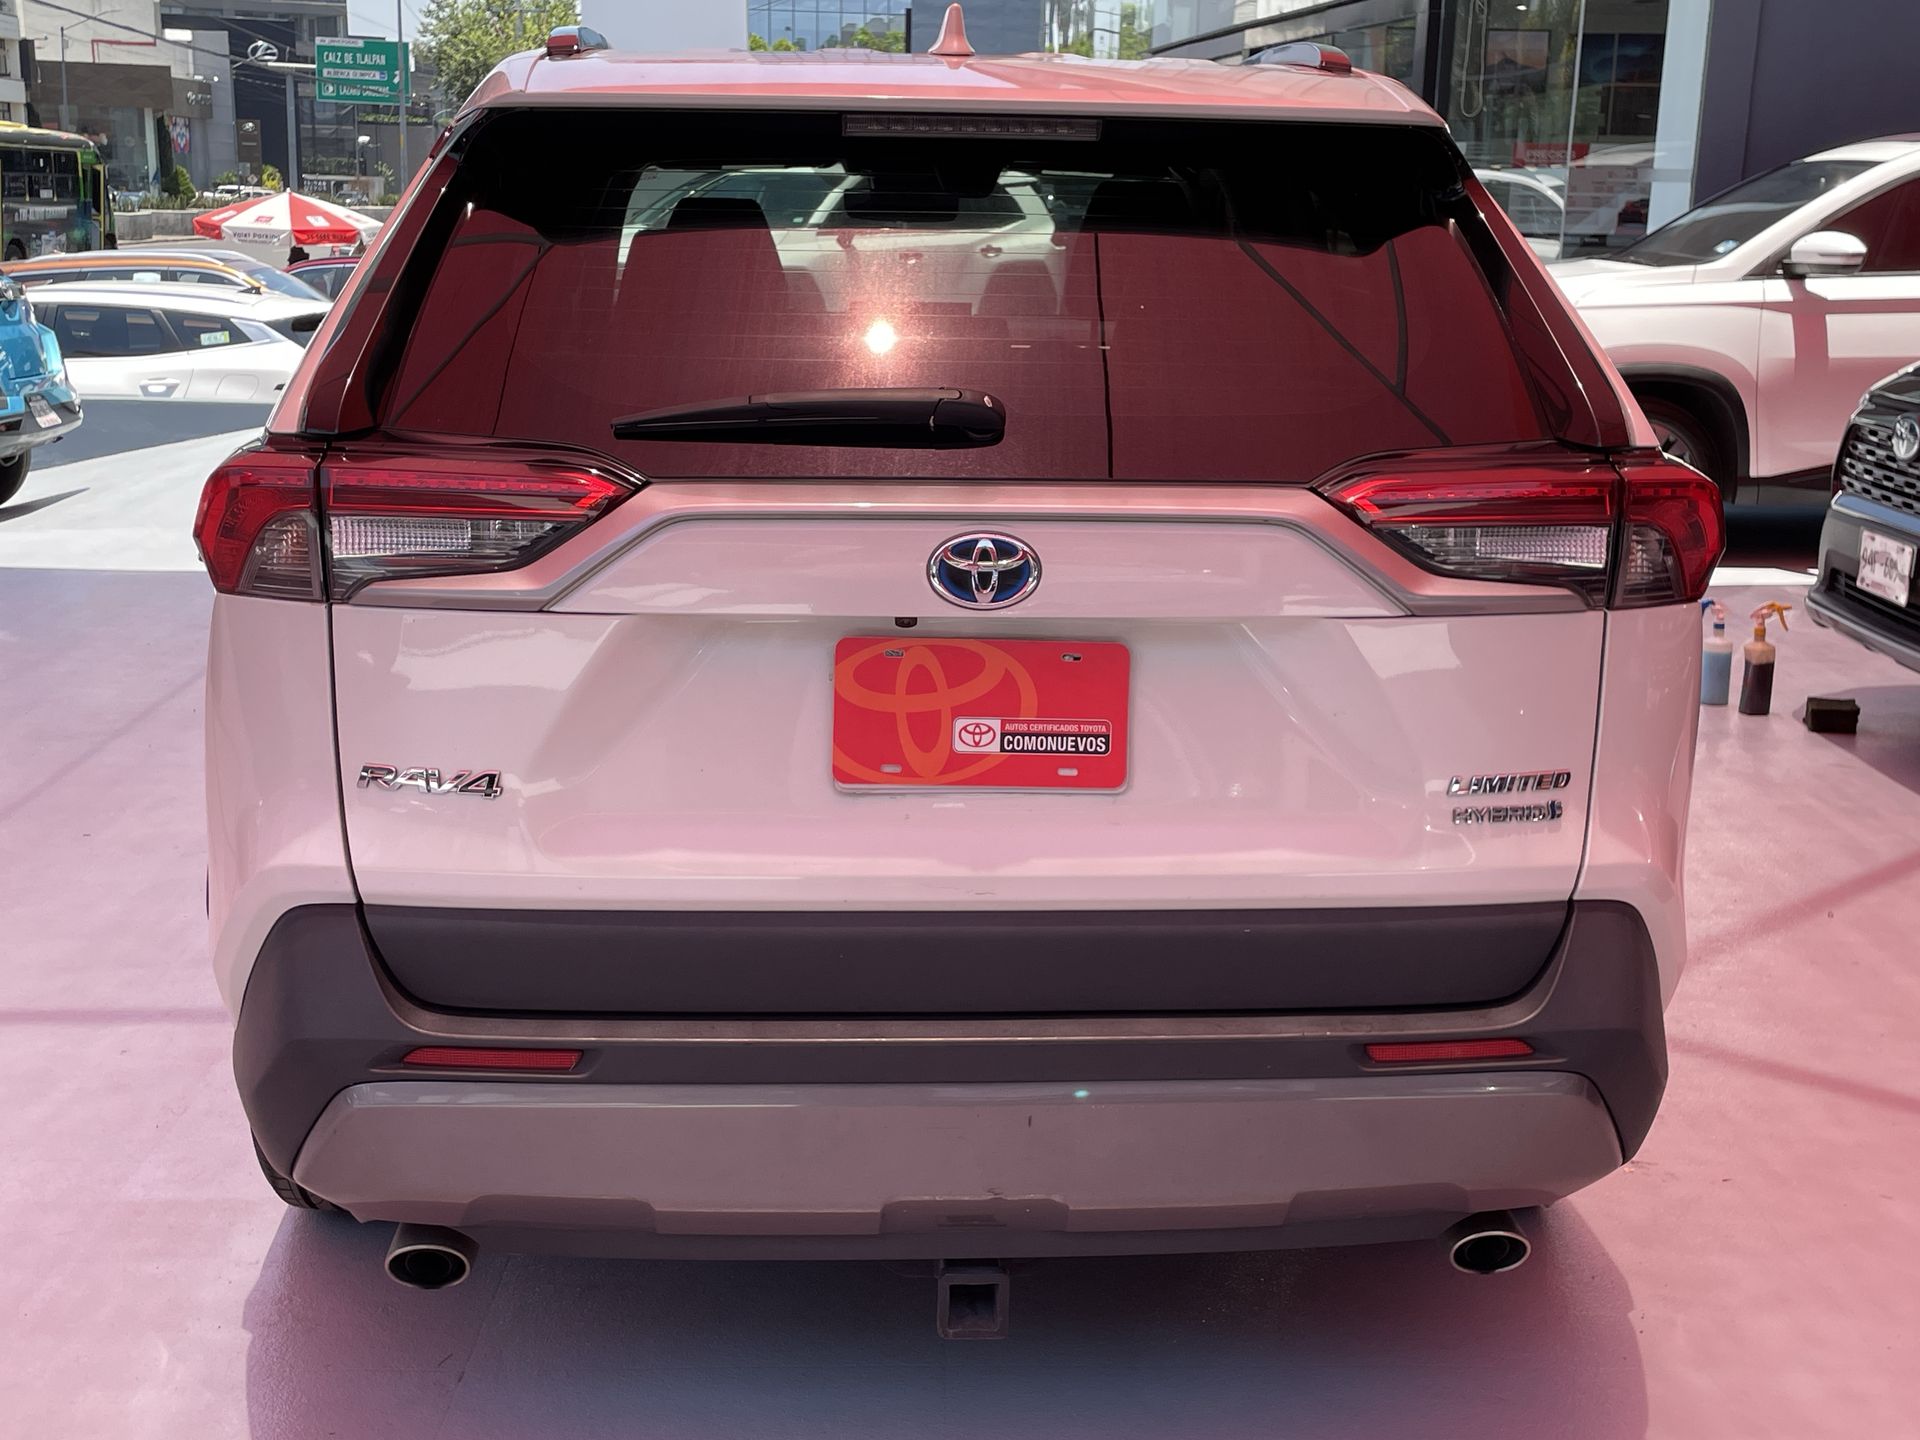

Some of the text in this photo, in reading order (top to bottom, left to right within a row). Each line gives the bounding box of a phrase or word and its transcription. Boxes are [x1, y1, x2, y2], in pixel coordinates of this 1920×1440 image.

[344, 53, 353, 64] DE
[356, 53, 386, 65] TLALPAN
[1004, 723, 1107, 733] AUTOS CERTIFICADOS TOYOTA
[1003, 735, 1106, 752] COMONUEVOS
[357, 763, 503, 800] RAV4
[1446, 769, 1571, 796] LIMITED
[1452, 804, 1546, 824] HYBRID
